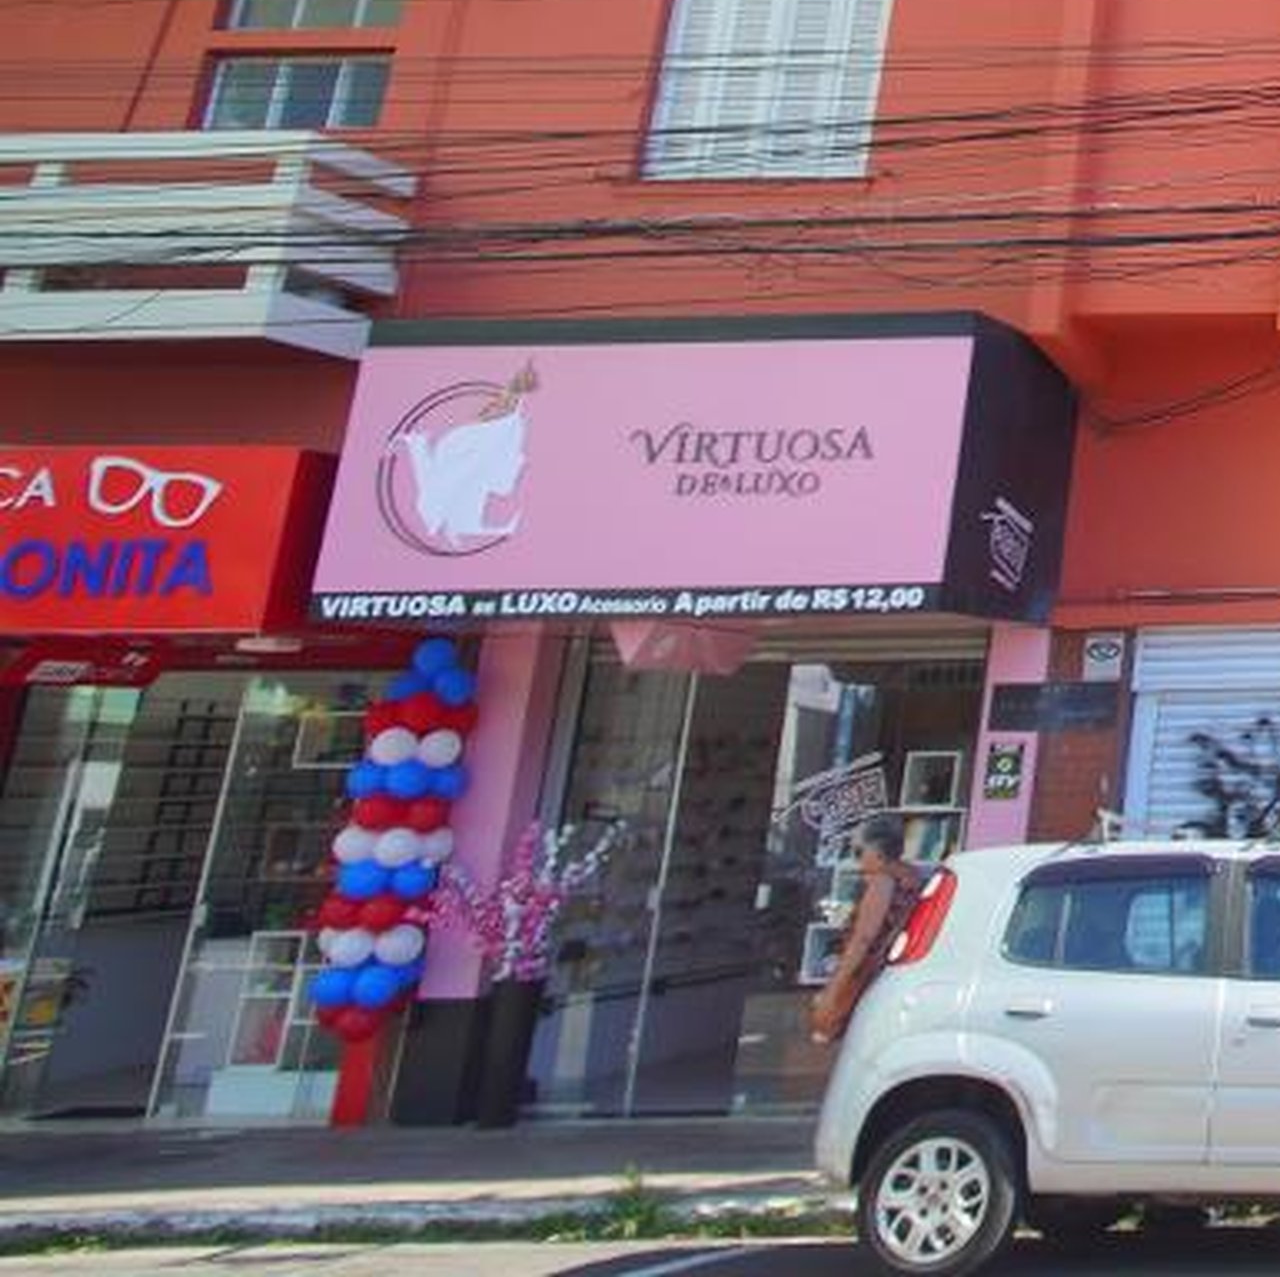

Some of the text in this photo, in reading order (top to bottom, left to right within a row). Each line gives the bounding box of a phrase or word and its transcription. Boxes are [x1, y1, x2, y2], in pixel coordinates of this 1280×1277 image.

[630, 421, 874, 469] VIRTUOSA
[677, 472, 821, 497] DE LUXO
[320, 595, 466, 618] VIRTUOSA
[501, 593, 578, 614] LUXO
